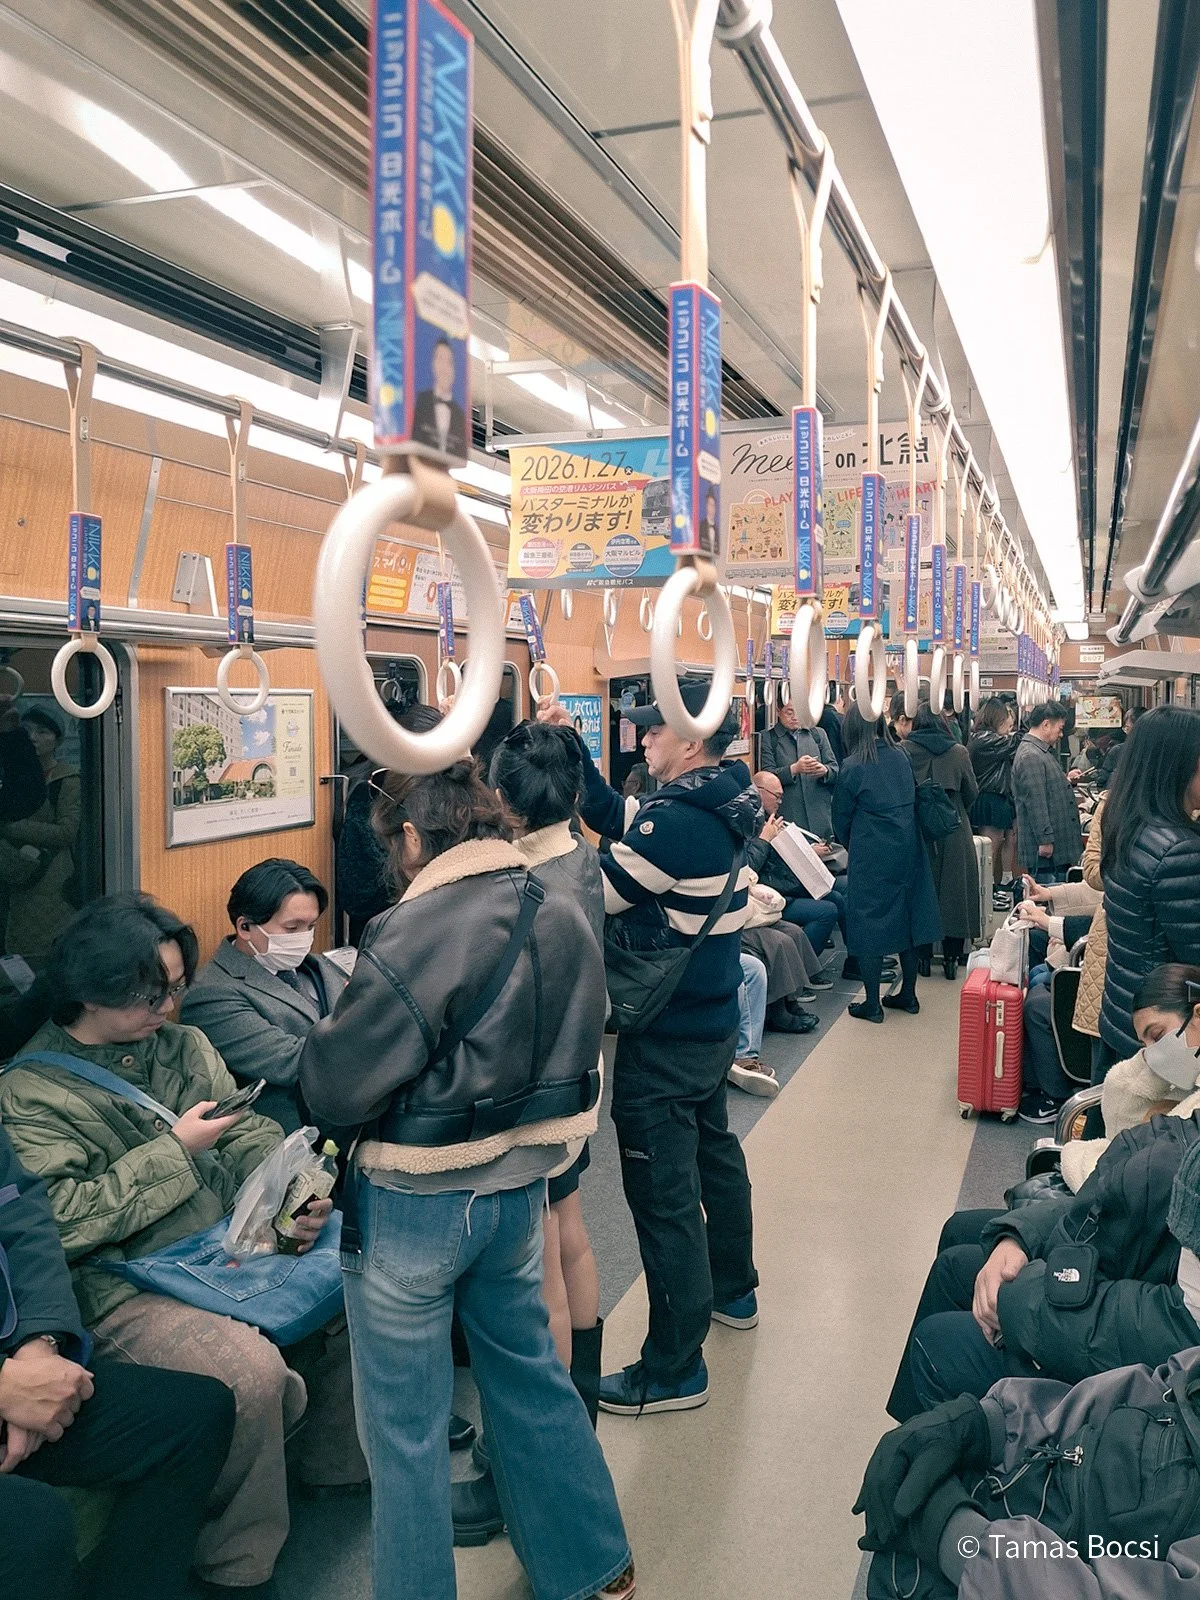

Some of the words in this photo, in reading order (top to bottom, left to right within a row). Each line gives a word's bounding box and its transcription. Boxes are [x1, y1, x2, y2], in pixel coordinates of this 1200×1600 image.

[379, 151, 403, 285] 日光ホーム
[676, 299, 690, 374] ニッコニコ
[675, 380, 690, 457] 日光ホーム
[520, 451, 628, 481] 2026.1.27
[799, 418, 810, 471] ニッコニコ
[833, 452, 856, 469] on
[520, 493, 636, 512] バスターミナルが
[799, 476, 811, 530] 日光ホーム
[837, 486, 862, 503] LIFE
[864, 481, 875, 523] ニッコニコ
[863, 525, 873, 568] 日光ホーム
